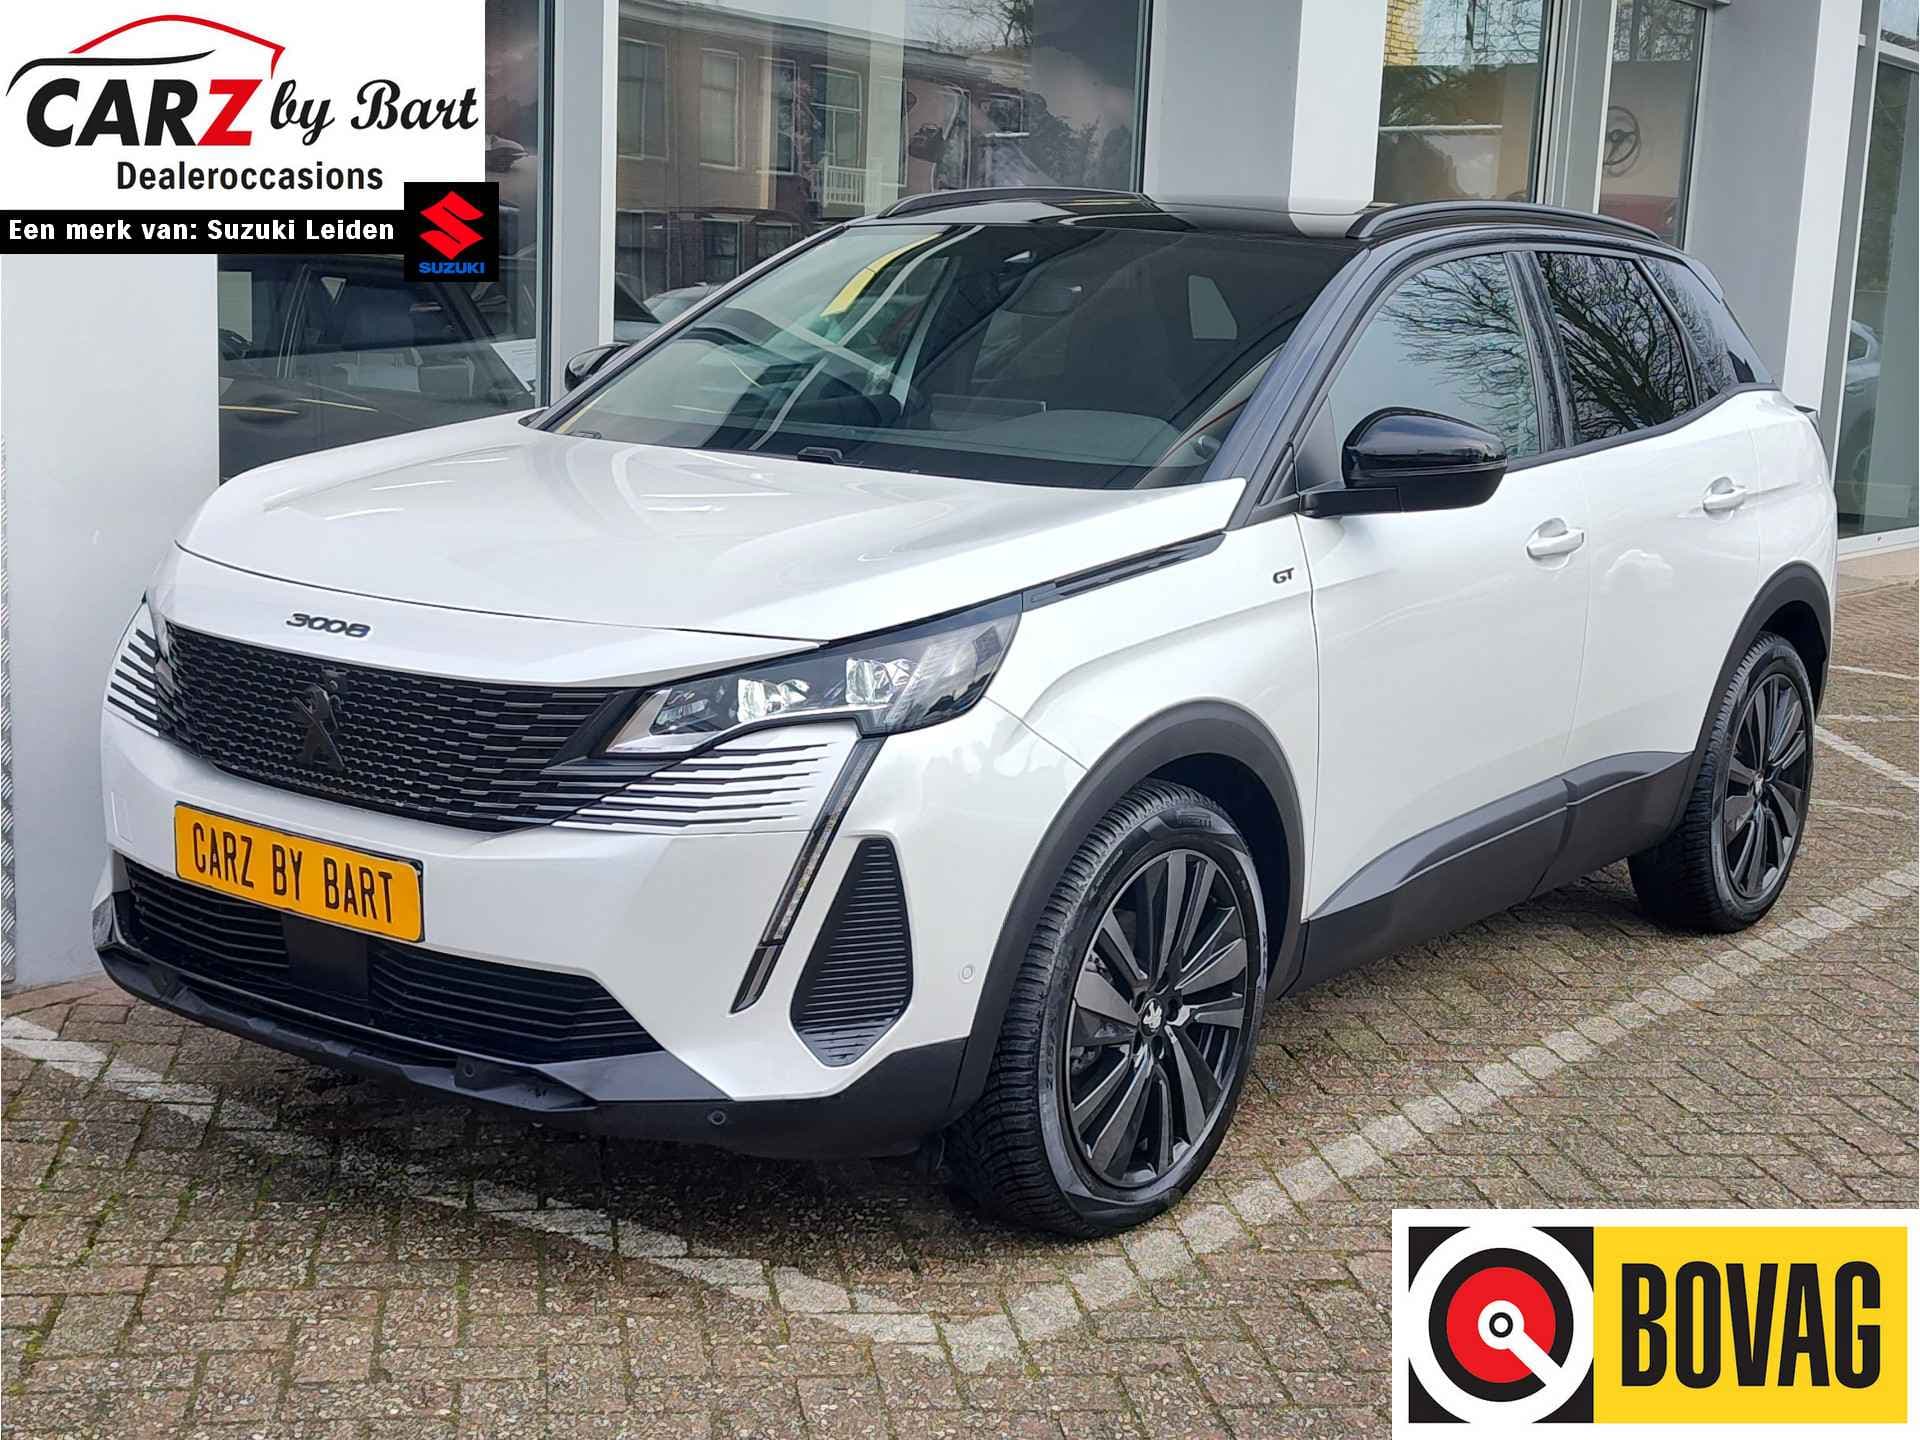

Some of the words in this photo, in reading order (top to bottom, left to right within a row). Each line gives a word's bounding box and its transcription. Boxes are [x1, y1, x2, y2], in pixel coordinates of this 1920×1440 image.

[1272, 566, 1295, 585] GT
[286, 612, 371, 638] 3008
[192, 822, 255, 889] CARZ
[272, 844, 304, 901] BY
[323, 858, 394, 923] BART
